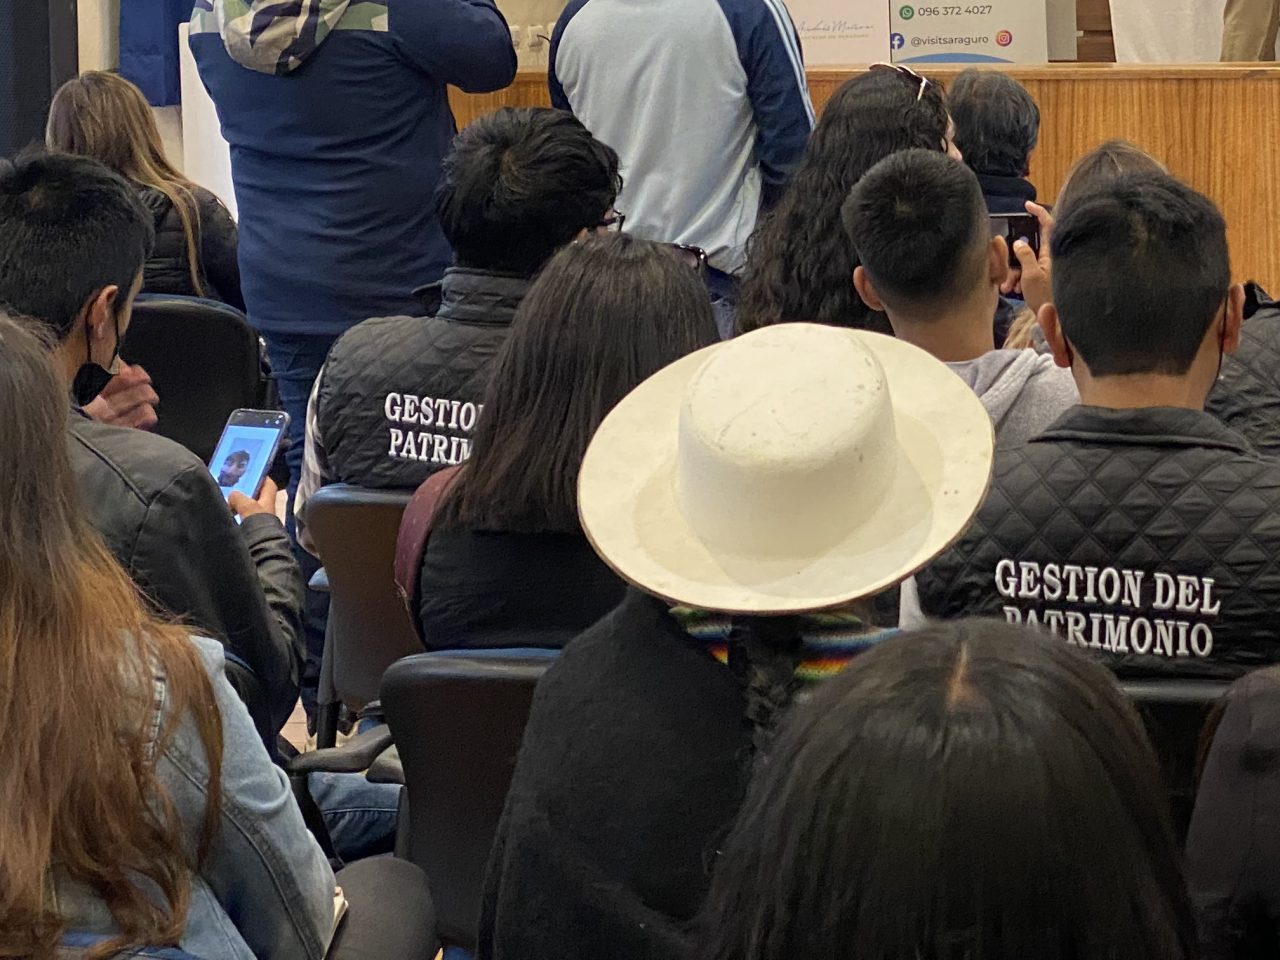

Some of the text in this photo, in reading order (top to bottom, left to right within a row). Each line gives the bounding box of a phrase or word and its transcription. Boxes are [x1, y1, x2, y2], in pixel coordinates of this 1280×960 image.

[917, 5, 993, 17] 096 372 4027
[910, 35, 990, 48] @visitsaraguro
[387, 427, 474, 465] PATRIM
[994, 558, 1222, 616] GESTION DEL
